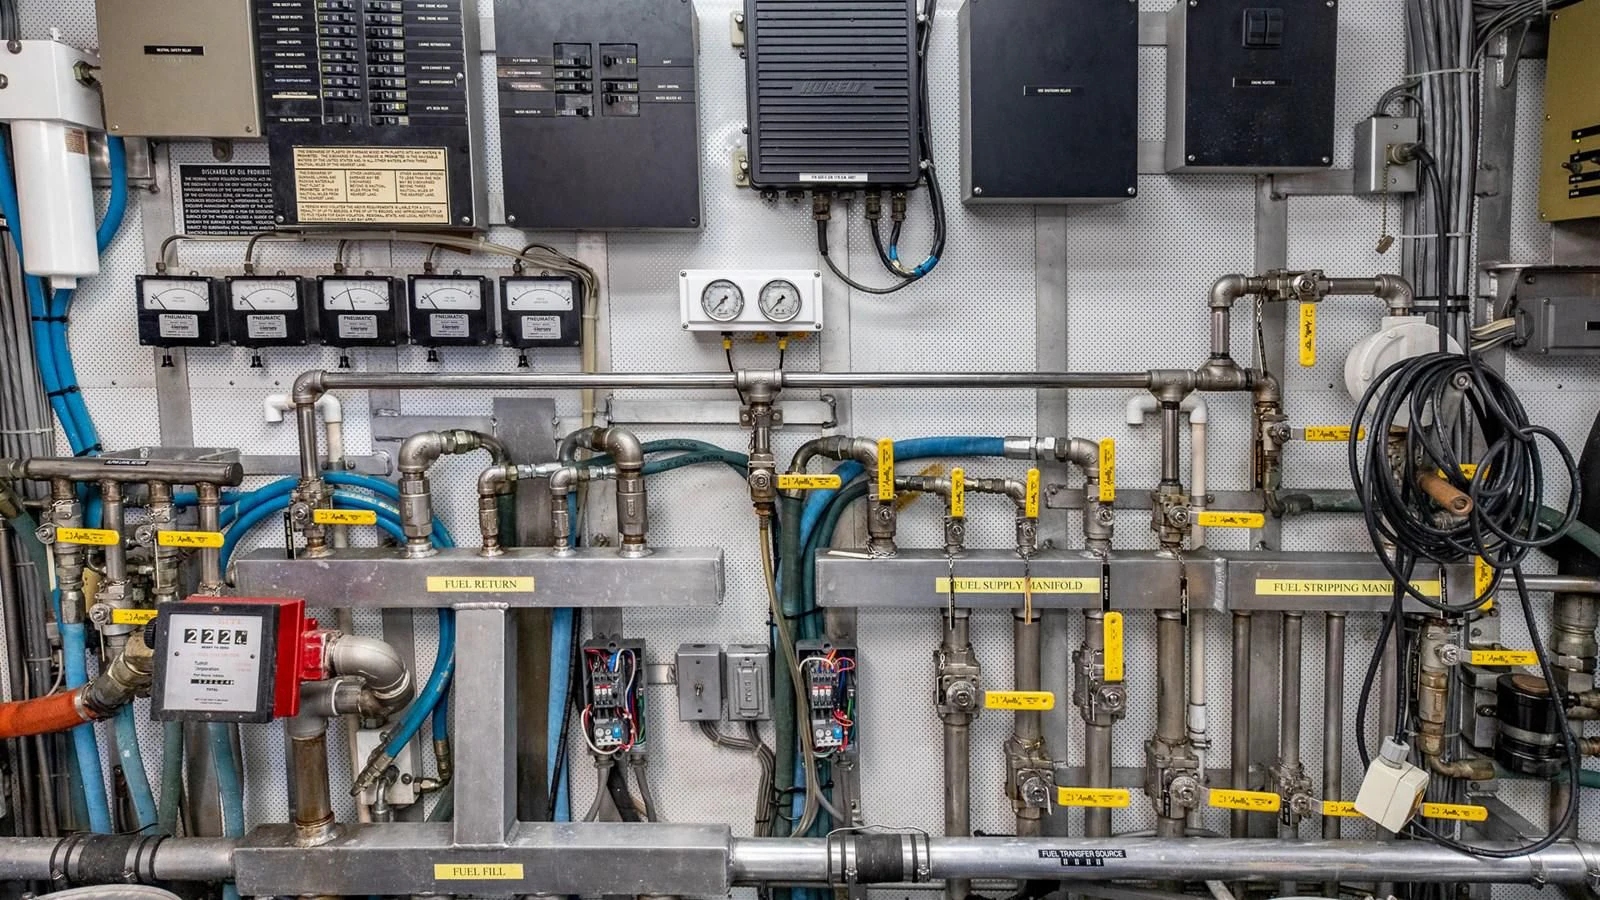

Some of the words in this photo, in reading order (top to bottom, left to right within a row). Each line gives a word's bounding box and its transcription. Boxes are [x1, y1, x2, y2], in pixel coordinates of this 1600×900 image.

[445, 580, 472, 589] FUEL
[474, 580, 517, 589] RETURN
[954, 581, 981, 590] FUEL
[983, 581, 1022, 590] SUPPLY
[1274, 583, 1300, 592] FUEL
[1303, 583, 1359, 592] STRIPPING
[454, 867, 480, 876] FUEL
[483, 867, 506, 876] FILL
